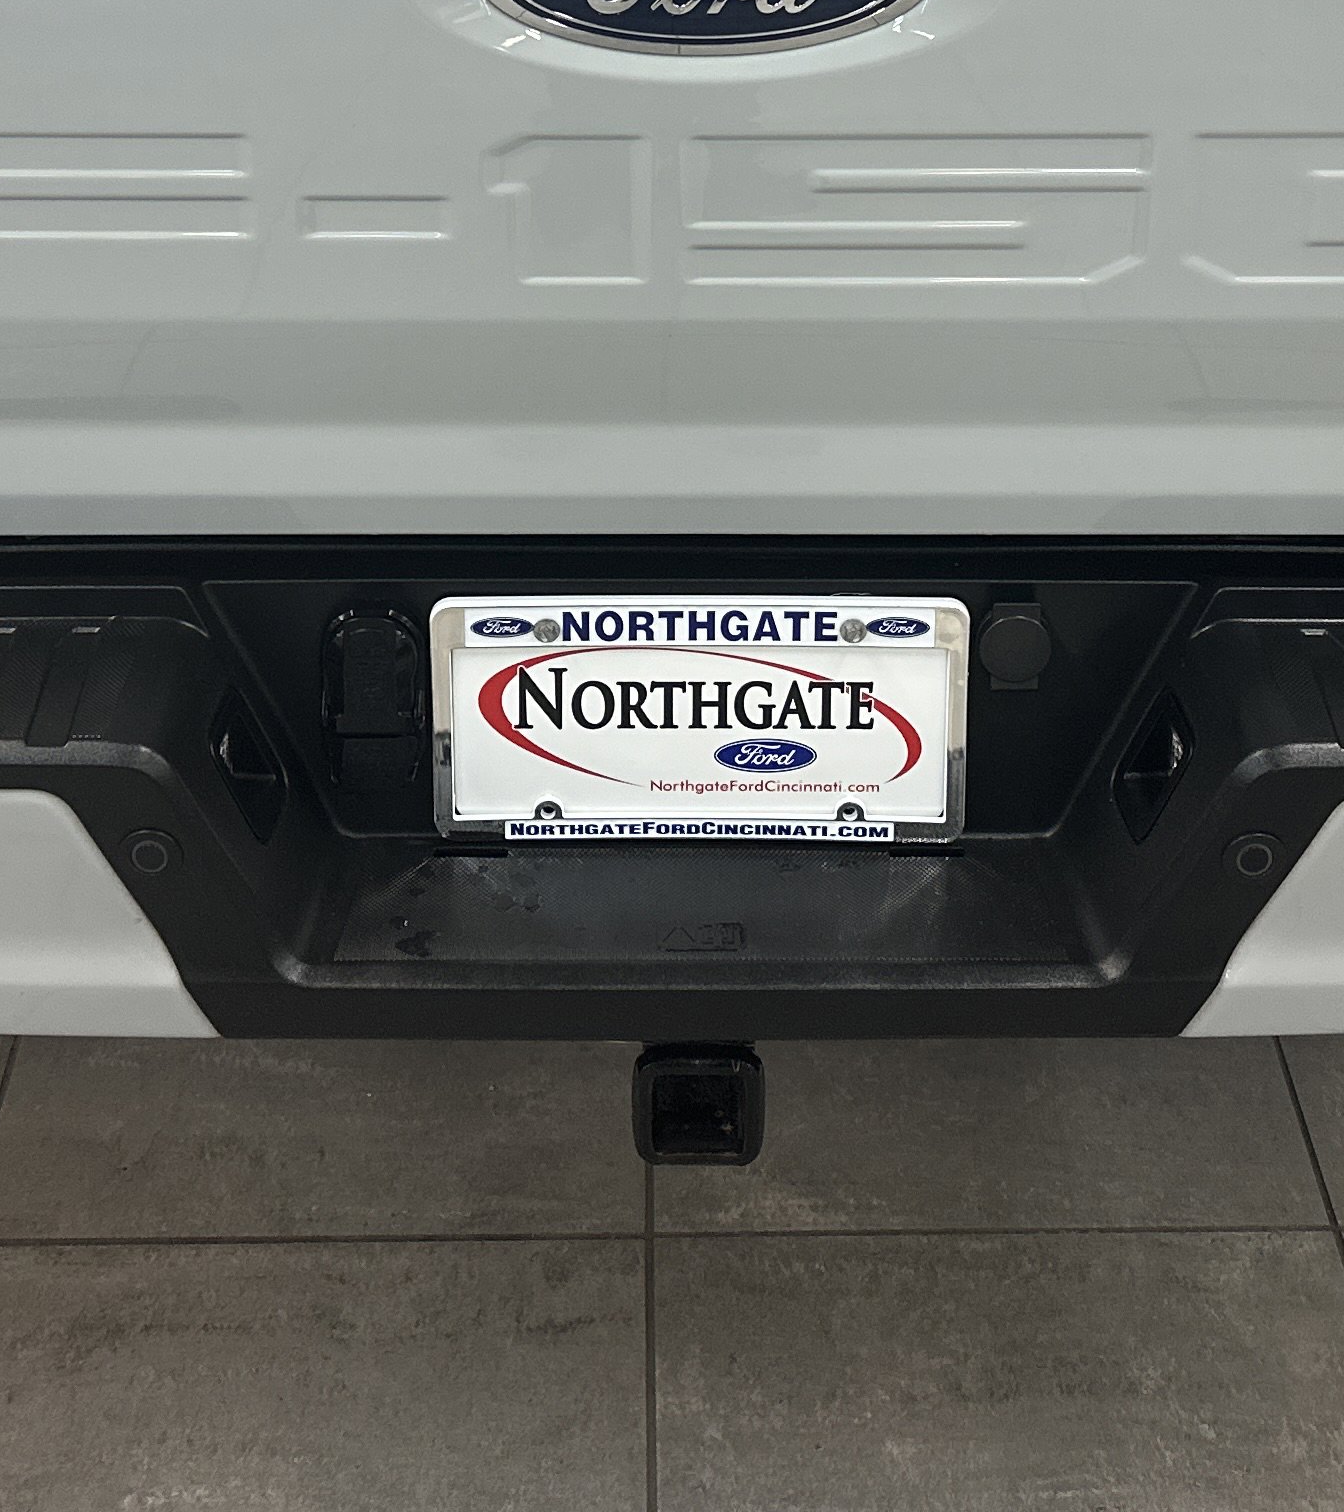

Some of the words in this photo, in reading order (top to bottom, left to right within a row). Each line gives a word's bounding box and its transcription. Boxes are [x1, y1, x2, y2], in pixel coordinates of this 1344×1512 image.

[482, 619, 521, 635] Ford
[561, 609, 838, 642] NORTHGATE
[878, 619, 917, 635] Ford
[513, 666, 875, 730] NORTHGATE
[734, 743, 795, 766] Ford
[650, 779, 881, 795] NorthgateFordCincinnati.com
